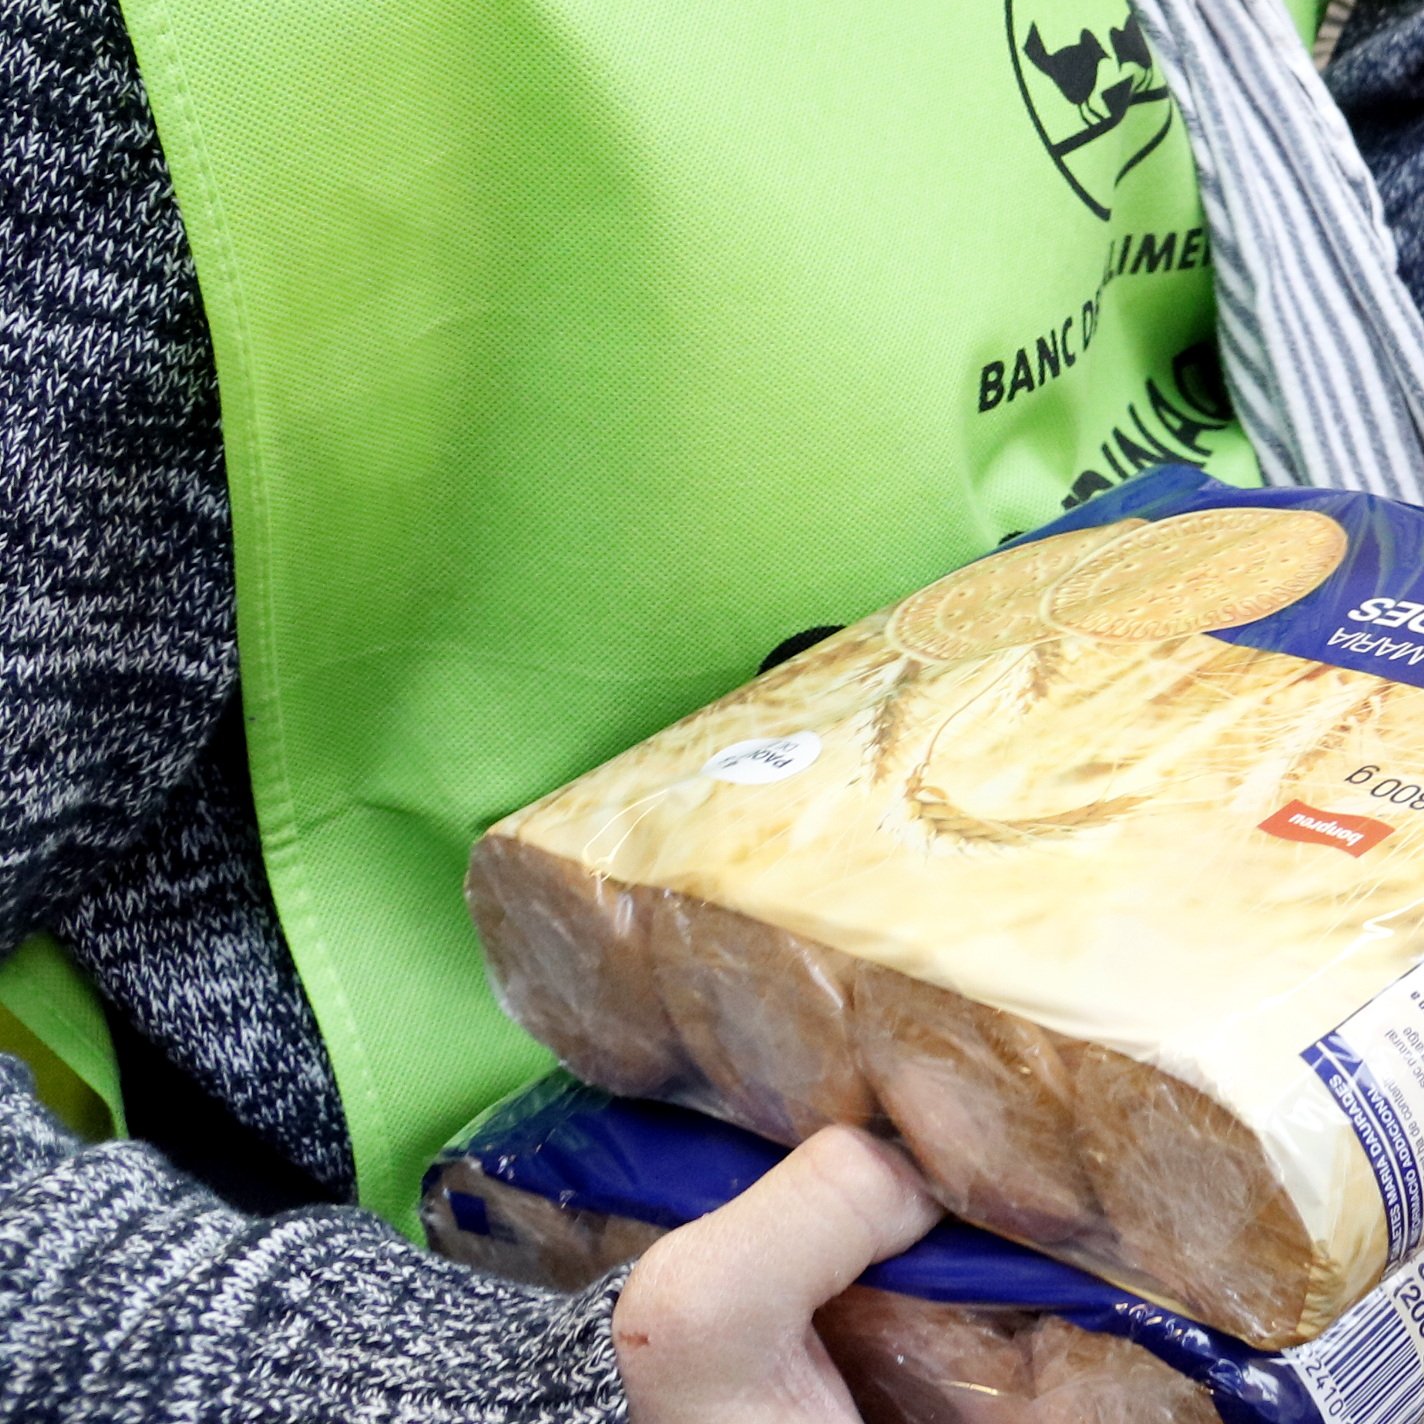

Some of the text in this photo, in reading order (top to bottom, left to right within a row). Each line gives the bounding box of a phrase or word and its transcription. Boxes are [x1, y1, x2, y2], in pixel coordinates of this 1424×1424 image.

[978, 316, 1076, 414] BANC
[1345, 765, 1380, 784] g
[1290, 814, 1362, 845] bonpreu
[1410, 990, 1421, 1000] a
[1328, 1073, 1382, 1157] DAURADES
[1365, 1082, 1414, 1168] ADDICIONAL
[1405, 1120, 1419, 1136] de
[1414, 1136, 1424, 1151] ha
[1374, 1154, 1398, 1205] MARIA
